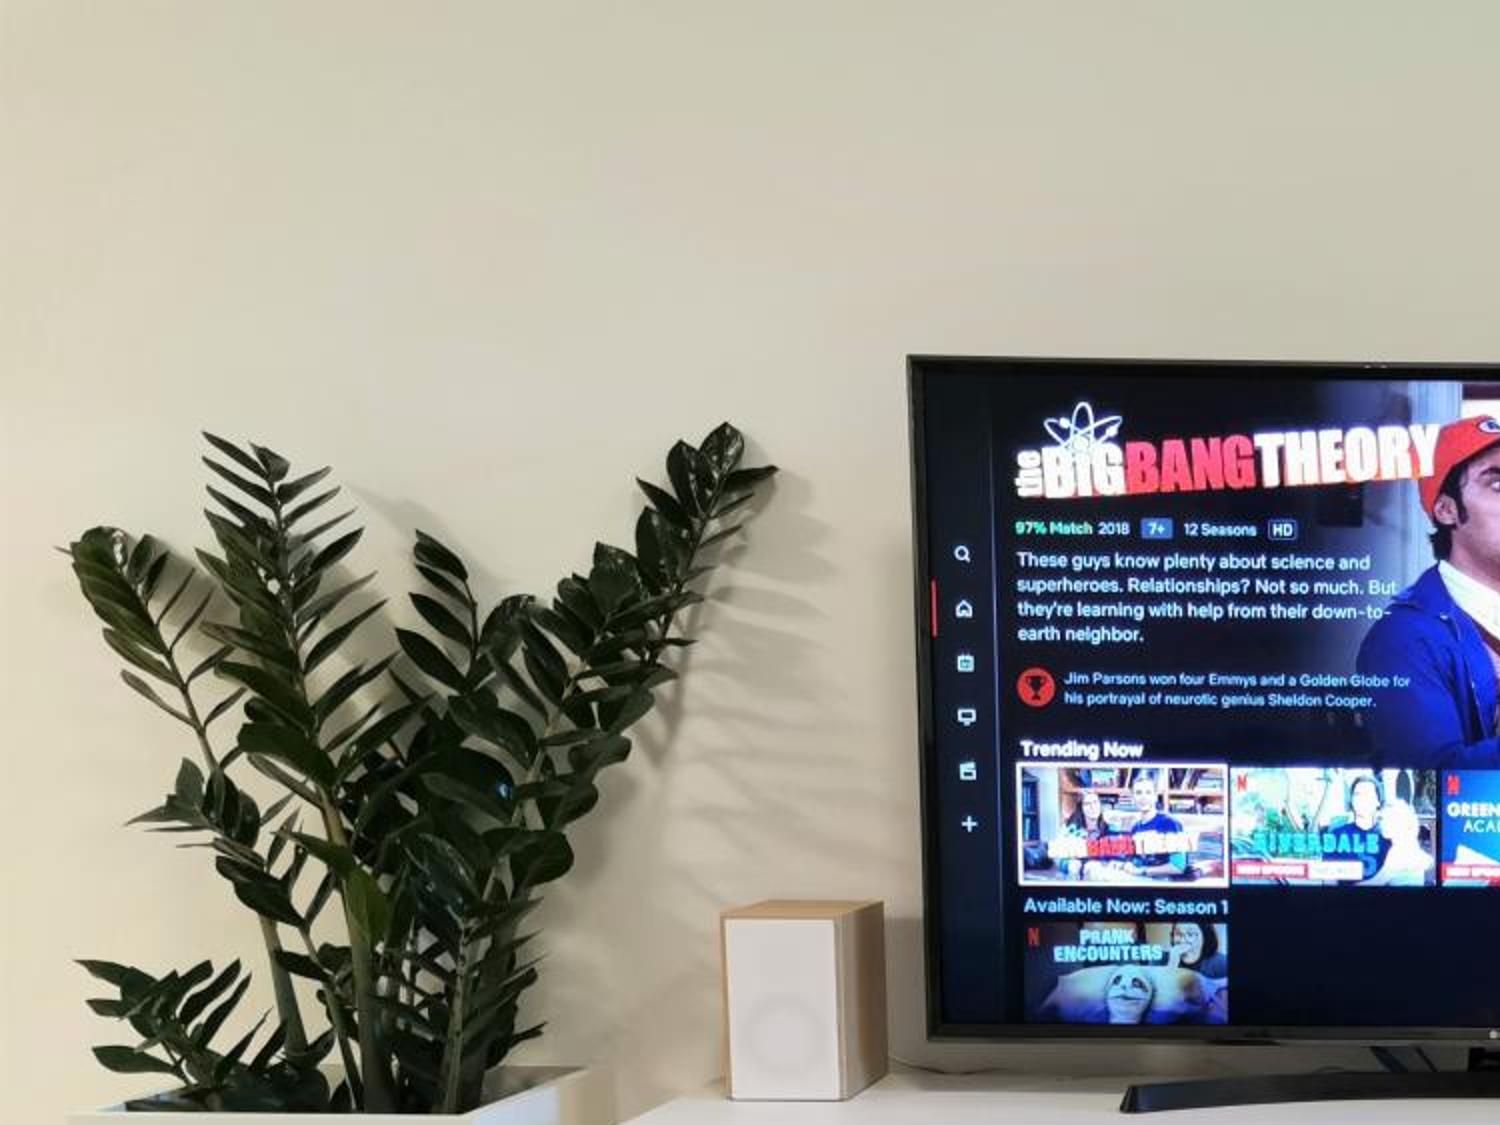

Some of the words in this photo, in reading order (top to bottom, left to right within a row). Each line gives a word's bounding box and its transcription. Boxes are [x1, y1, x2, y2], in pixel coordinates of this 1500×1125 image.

[1125, 434, 1256, 494] BANG
[1253, 424, 1440, 488] THEORY
[1015, 520, 1047, 535] 97%
[1051, 521, 1093, 535] Match
[1098, 521, 1130, 535] 2018
[1147, 522, 1165, 535] 7+
[1183, 522, 1198, 536] 12
[1201, 522, 1257, 537] Seasons
[1273, 523, 1293, 537] HD
[1016, 552, 1068, 568] These
[1072, 555, 1110, 572] guys
[1115, 553, 1160, 568] know
[1164, 553, 1215, 572] plenty
[1219, 553, 1267, 569] about
[1271, 554, 1335, 570] science
[1338, 554, 1371, 570] and
[1016, 577, 1124, 595] superheroes.
[1128, 577, 1249, 597] Relationships?
[1255, 579, 1287, 594] Not
[1290, 582, 1309, 595] so
[1314, 579, 1364, 595] much.
[1369, 579, 1397, 595] But
[1016, 601, 1073, 619] they're
[1077, 602, 1145, 621] learning
[1149, 602, 1183, 618] with
[1187, 602, 1224, 621] help
[1228, 603, 1267, 619] from
[1270, 603, 1308, 619] their
[1312, 603, 1392, 619] down-to-
[1016, 627, 1061, 642] earth
[1065, 627, 1145, 645] neighbor.
[1064, 672, 1090, 685] Jim
[1093, 672, 1146, 685] Parsons
[1150, 675, 1176, 686] won
[1179, 672, 1206, 686] four
[1209, 673, 1257, 688] Emmys
[1260, 674, 1285, 687] and
[1287, 676, 1298, 687] a
[1300, 674, 1348, 687] Golden
[1350, 675, 1391, 688] Globe
[1393, 675, 1411, 688] for
[1064, 692, 1083, 705] his
[1087, 692, 1146, 707] portrayal
[1149, 692, 1163, 705] of
[1165, 693, 1218, 705] neurotic
[1221, 694, 1265, 709] genius
[1267, 694, 1322, 707] Sheldon
[1325, 694, 1377, 709] Cooper.
[1020, 740, 1099, 761] Trending
[1103, 742, 1144, 758] Now
[1024, 898, 1102, 914] Available
[1107, 899, 1150, 914] Now:
[1154, 898, 1217, 915] Season
[1079, 928, 1136, 945] PRANK
[1053, 945, 1163, 962] ENCOUNTERS
